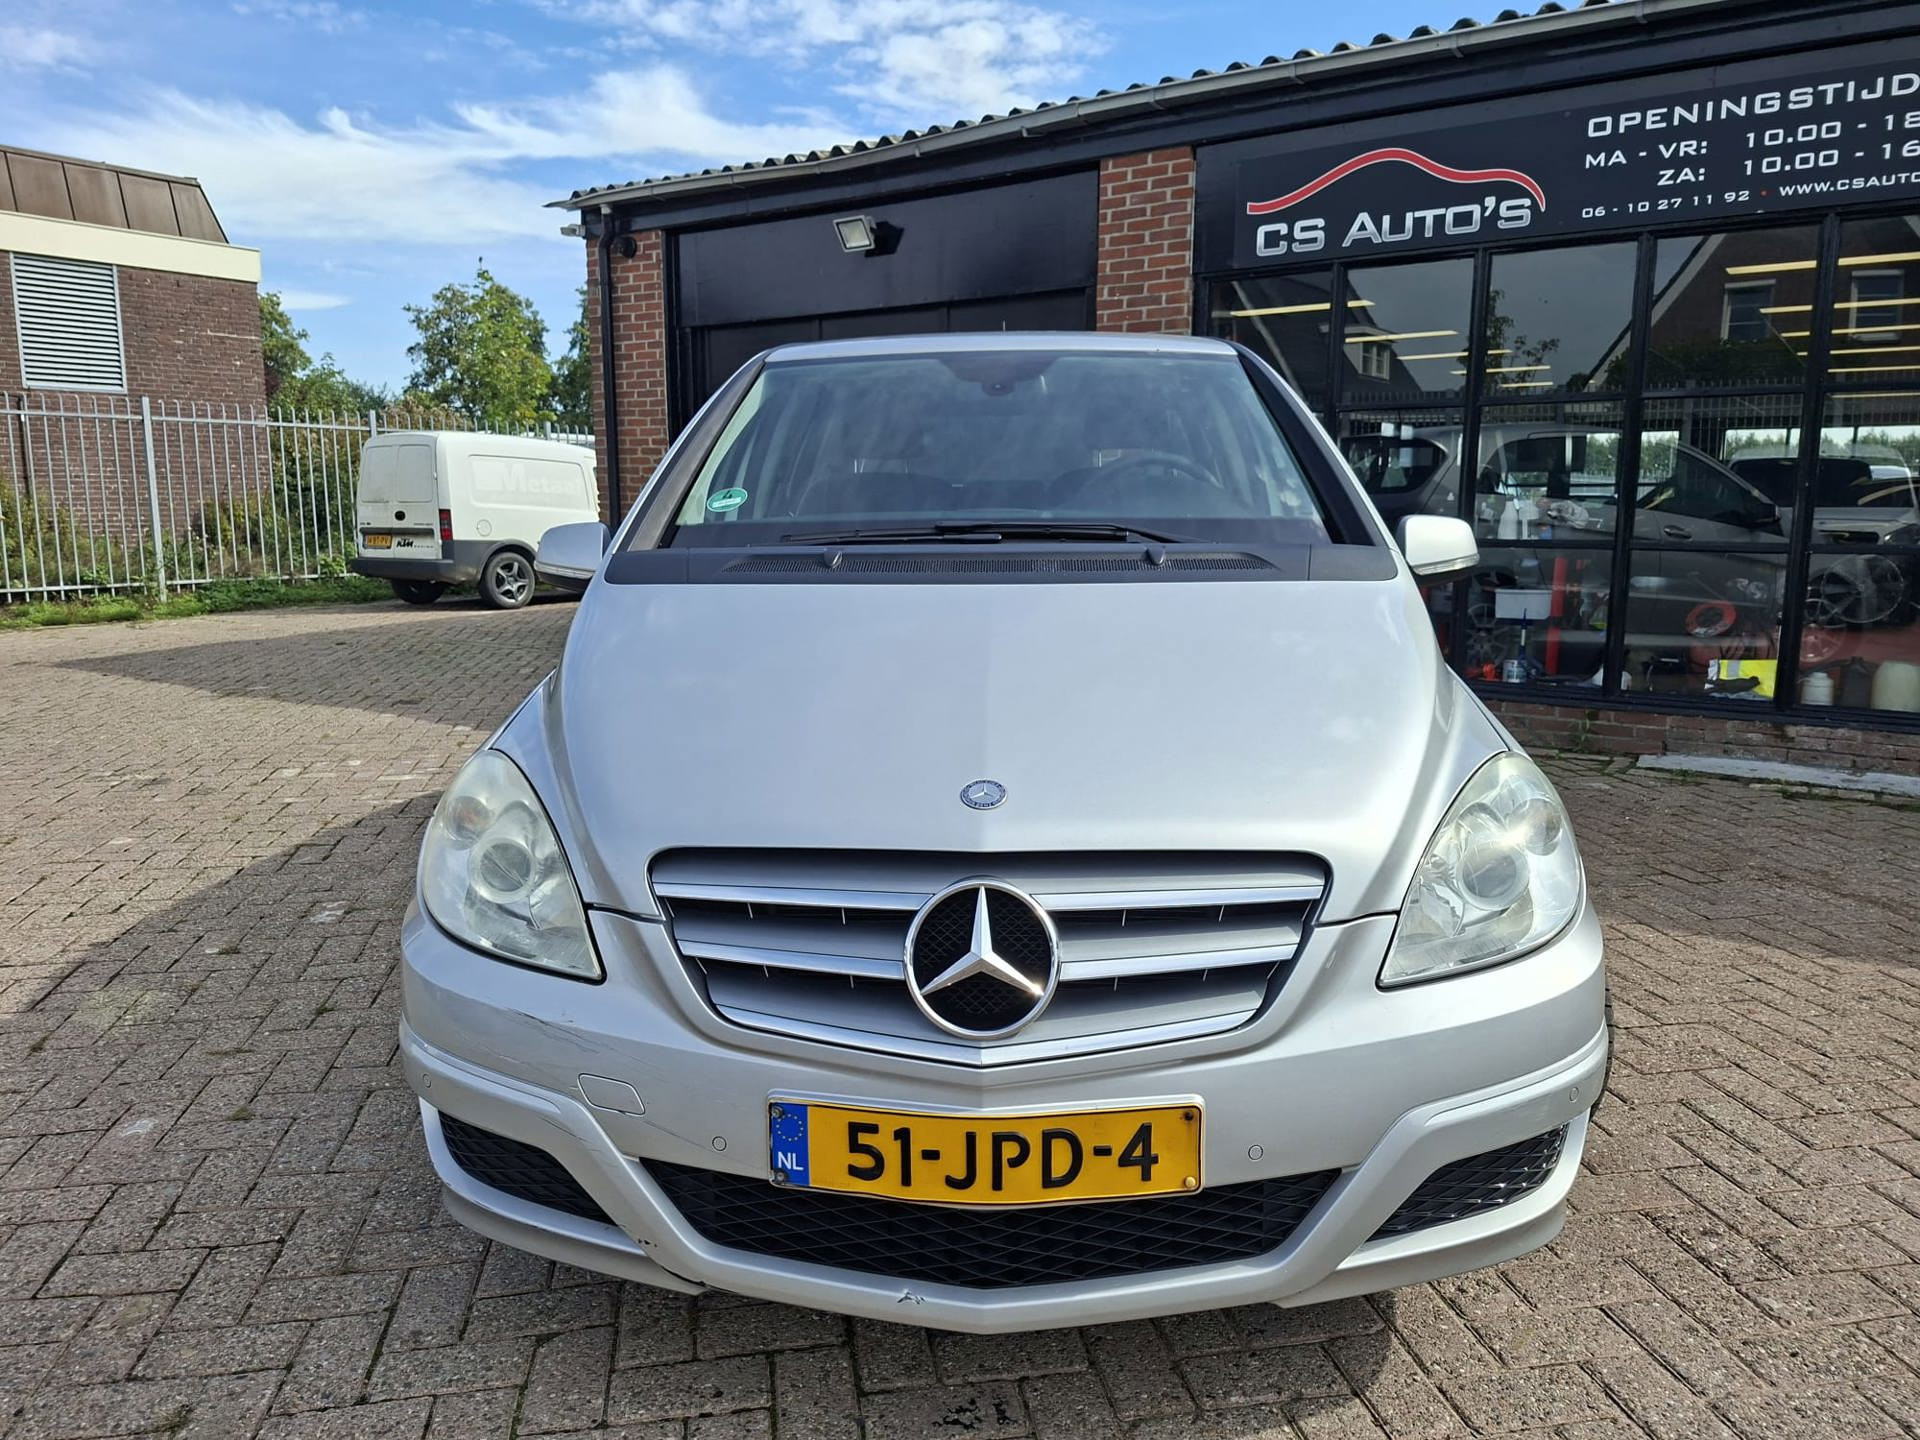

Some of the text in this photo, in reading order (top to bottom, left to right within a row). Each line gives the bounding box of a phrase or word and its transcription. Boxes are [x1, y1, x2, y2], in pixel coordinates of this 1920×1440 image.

[1588, 73, 1920, 137] OPENINGSTIJD
[1585, 150, 1627, 169] MA
[1658, 140, 1708, 159] VR:
[1746, 121, 1842, 148] 10.00
[1656, 167, 1706, 186] ZA:
[1744, 149, 1839, 176] 10.00
[1881, 139, 1920, 160] 16
[1581, 206, 1606, 219] 06
[1627, 201, 1650, 213] 10
[1657, 197, 1683, 210] 27
[1693, 194, 1713, 206] 11
[1724, 190, 1750, 203] 92
[1256, 217, 1326, 257] CS
[777, 1151, 804, 1170] NL
[847, 1121, 1159, 1191] 51-JPD-4
